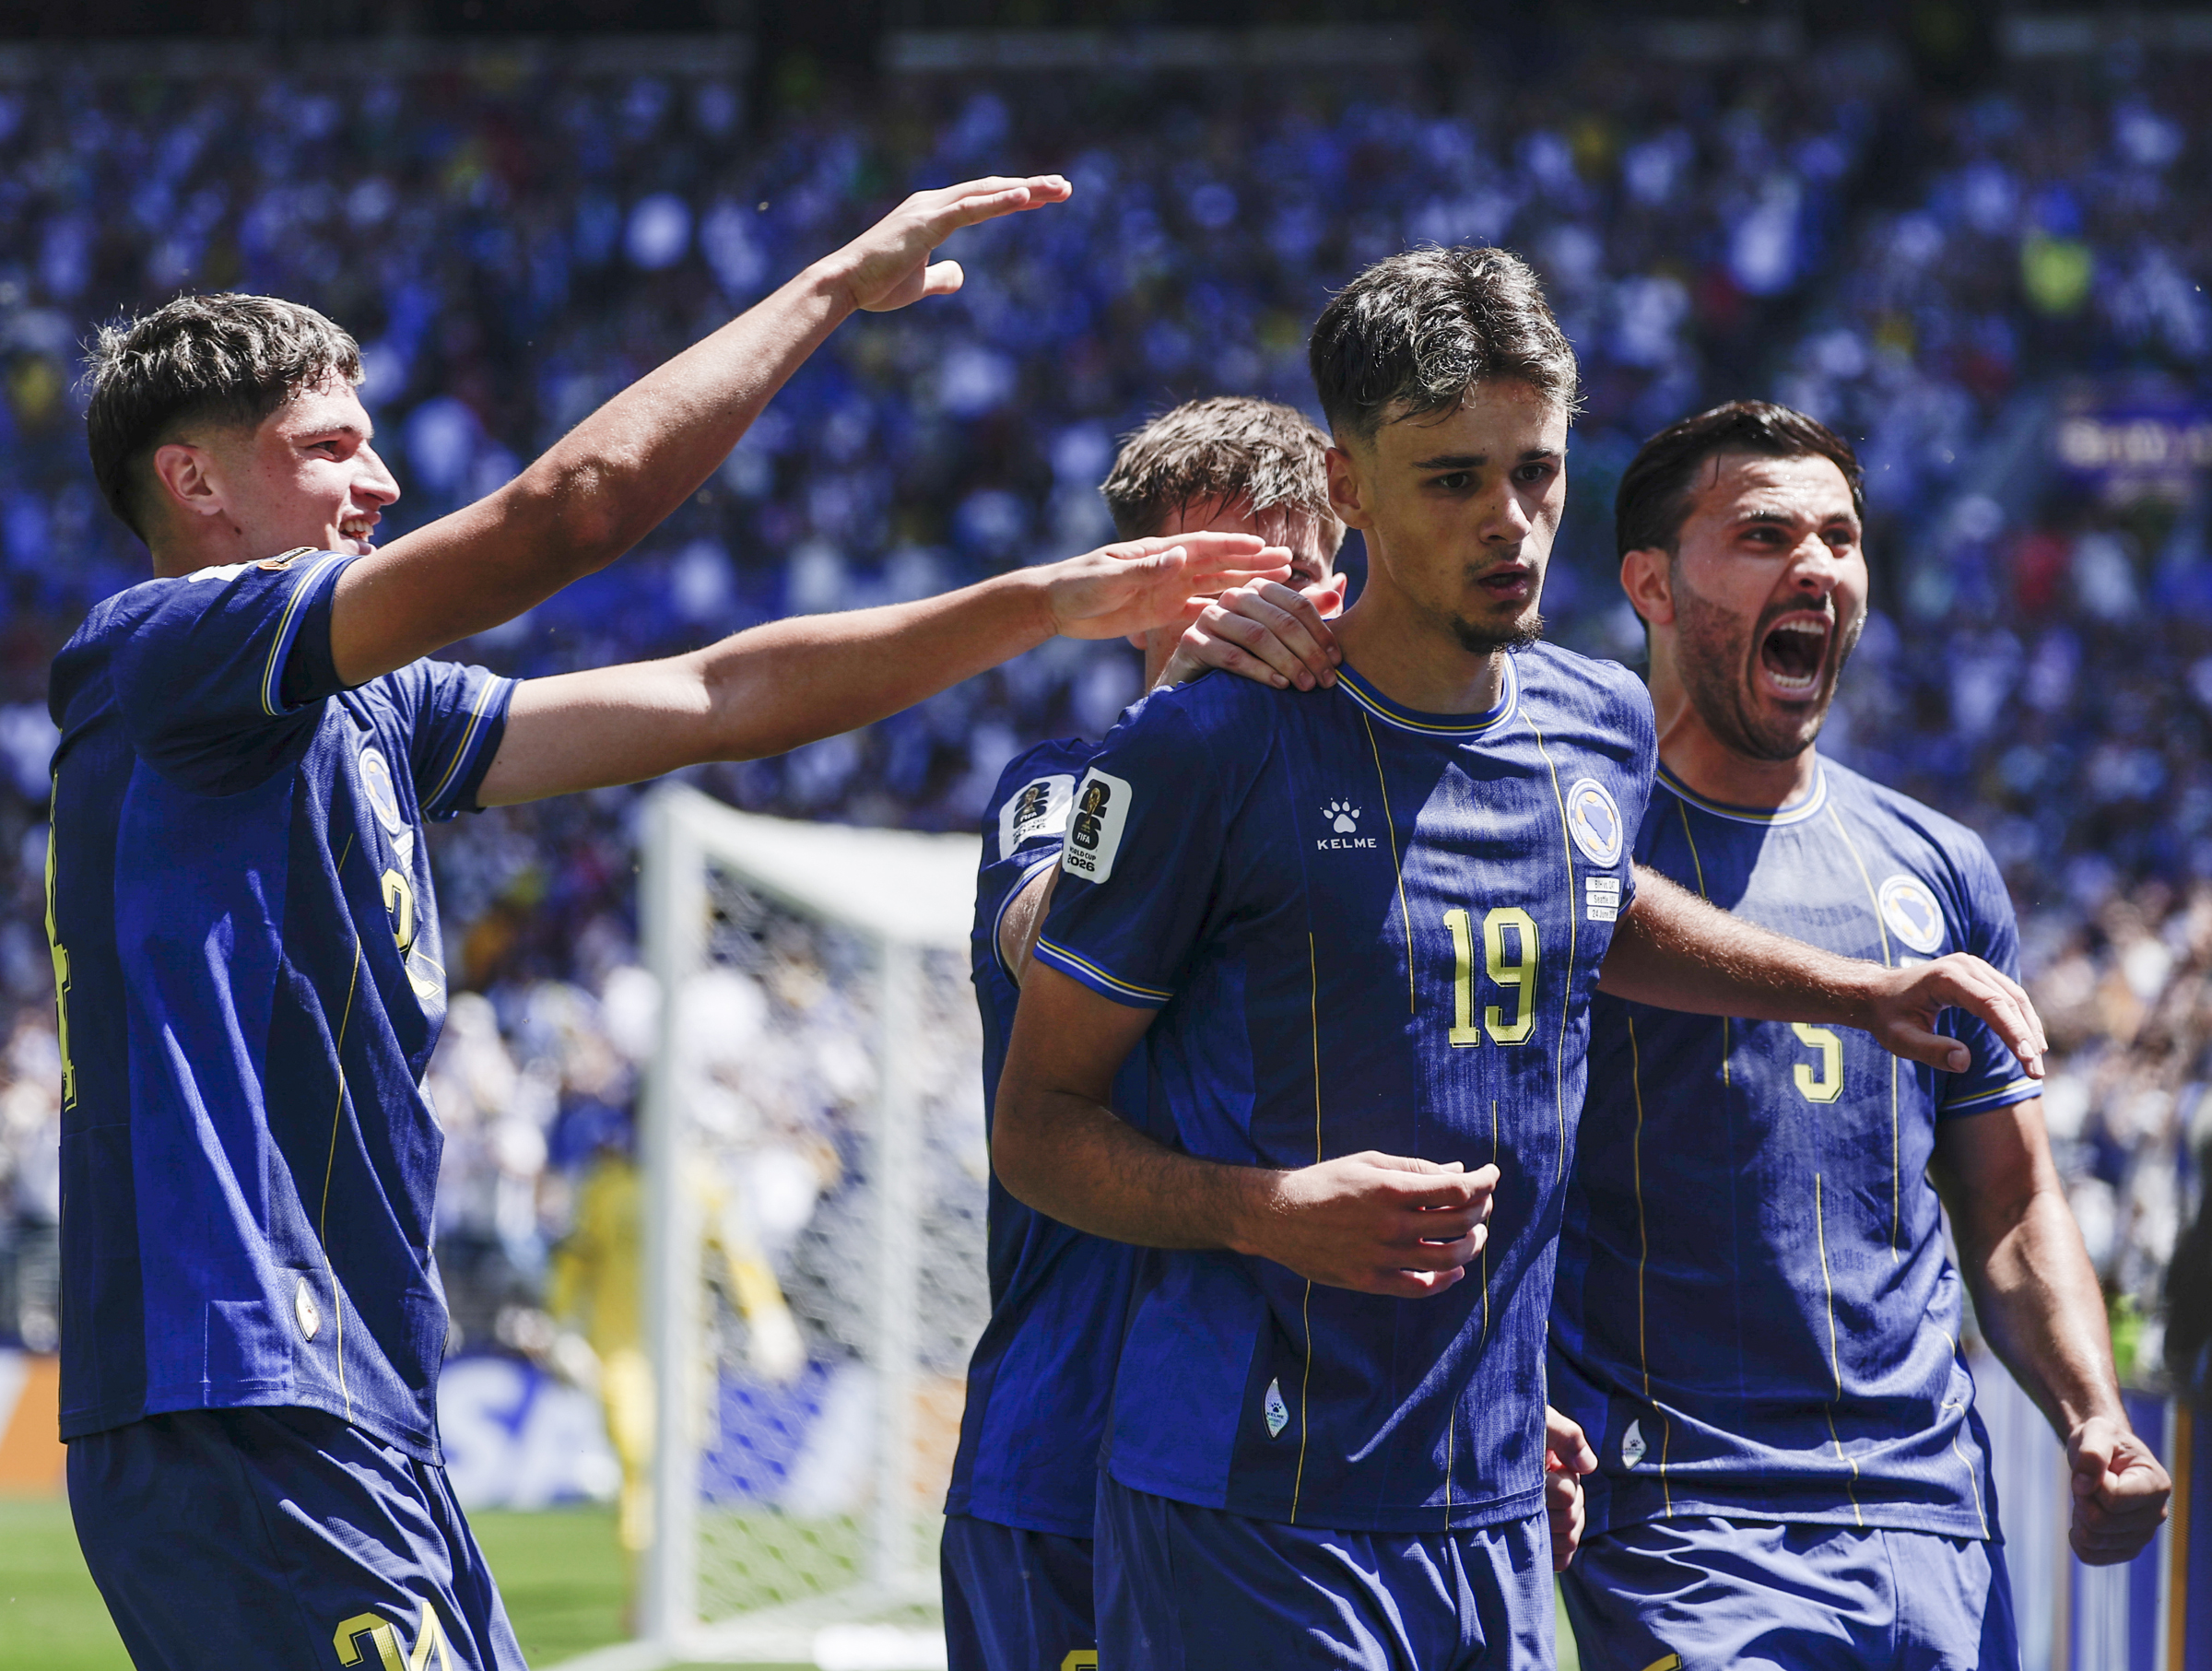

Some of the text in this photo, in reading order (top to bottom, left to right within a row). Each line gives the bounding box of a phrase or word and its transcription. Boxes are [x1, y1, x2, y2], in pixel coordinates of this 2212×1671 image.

[1019, 811, 1038, 822] FIFA
[1077, 831, 1090, 844] FIFA
[1317, 838, 1378, 850] KELME
[1066, 853, 1096, 873] 2026
[1084, 853, 1097, 862] CUP
[1442, 907, 1540, 1048] 19
